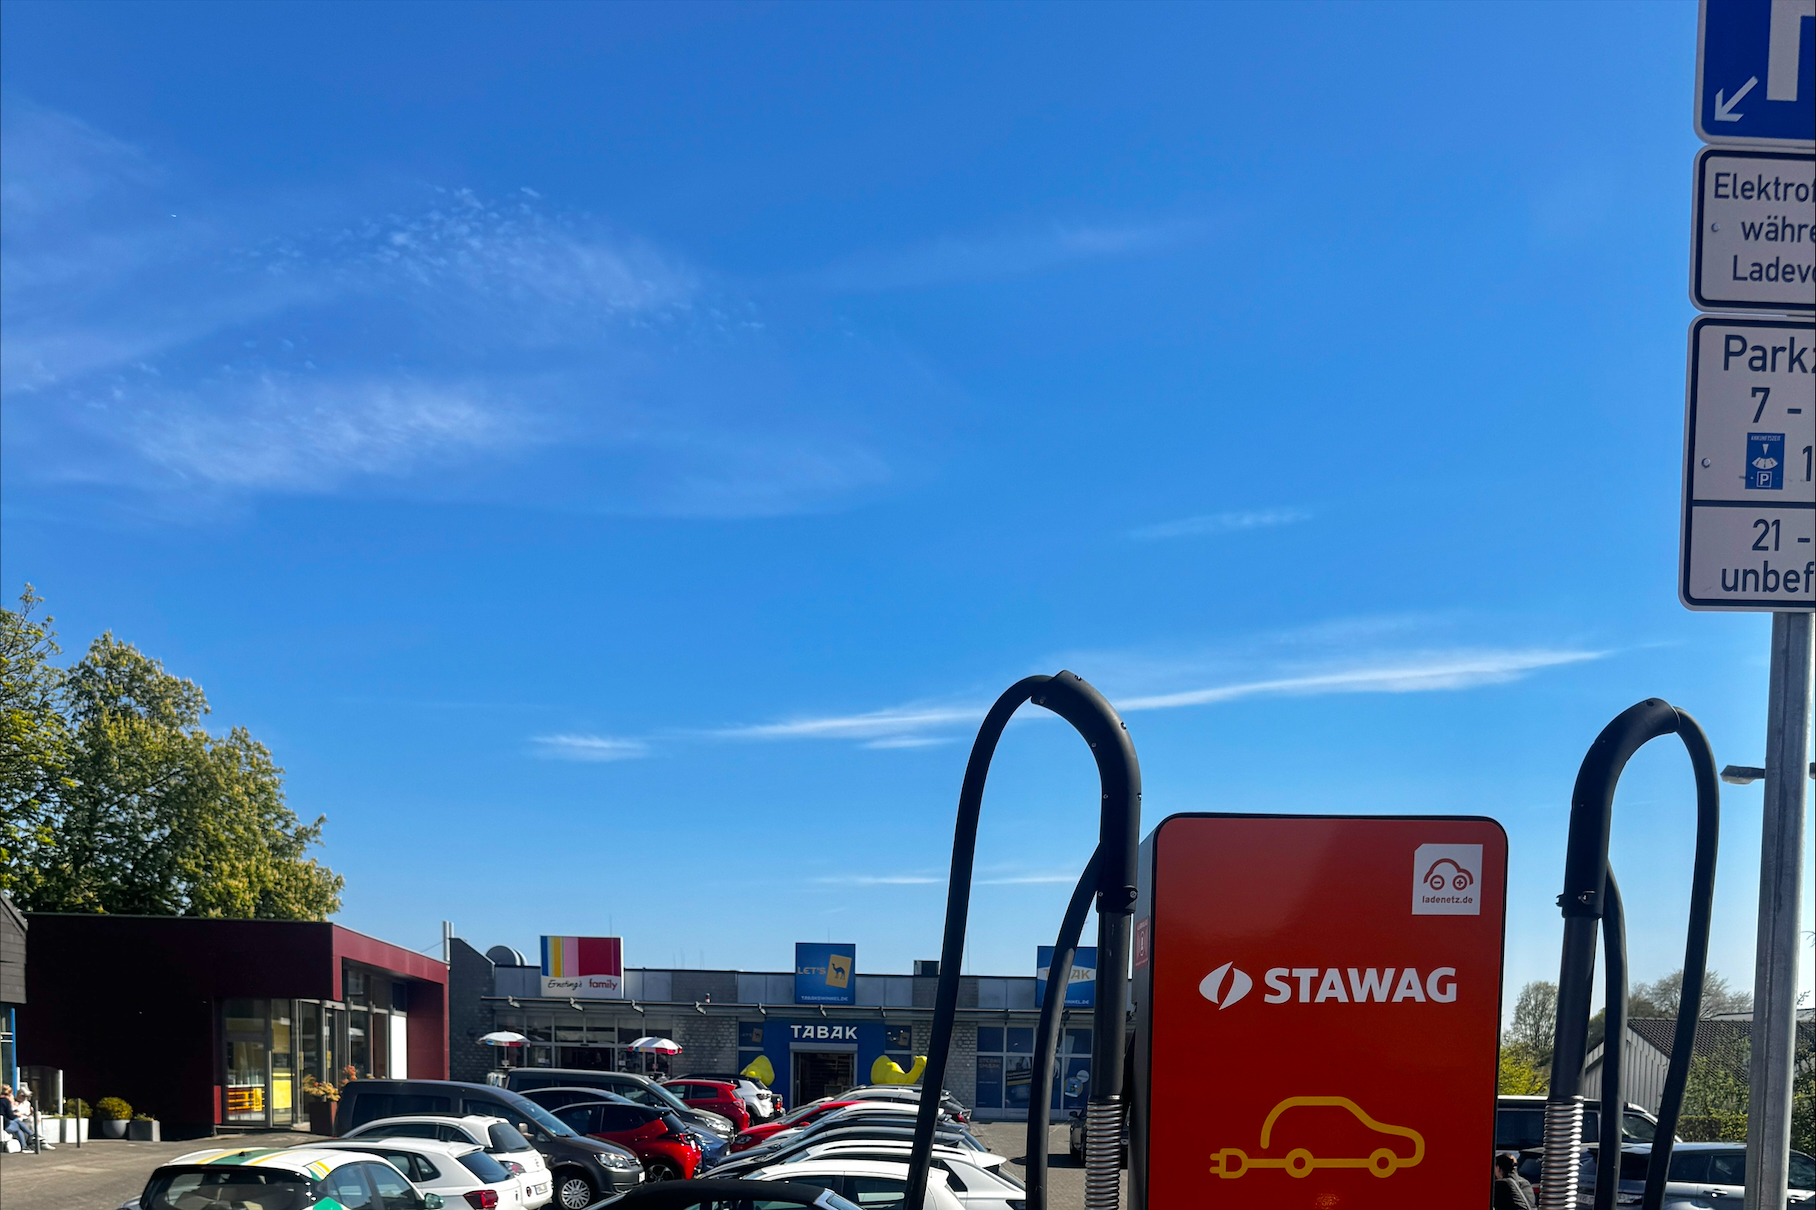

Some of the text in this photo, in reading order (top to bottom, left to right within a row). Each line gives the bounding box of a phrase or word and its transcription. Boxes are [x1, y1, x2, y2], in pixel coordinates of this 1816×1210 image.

[1732, 254, 1815, 283] Ladev
[1723, 334, 1815, 373] Park
[1751, 387, 1770, 424] 7
[1803, 446, 1813, 482] 1
[1760, 473, 1770, 485] P
[1752, 518, 1780, 551] 21
[1422, 895, 1473, 904] ladenetz.de
[797, 966, 826, 975] LET'S
[1043, 968, 1091, 980] TAK
[589, 978, 618, 991] family
[1264, 966, 1458, 1004] STAWAG
[790, 1024, 858, 1040] TABAK
